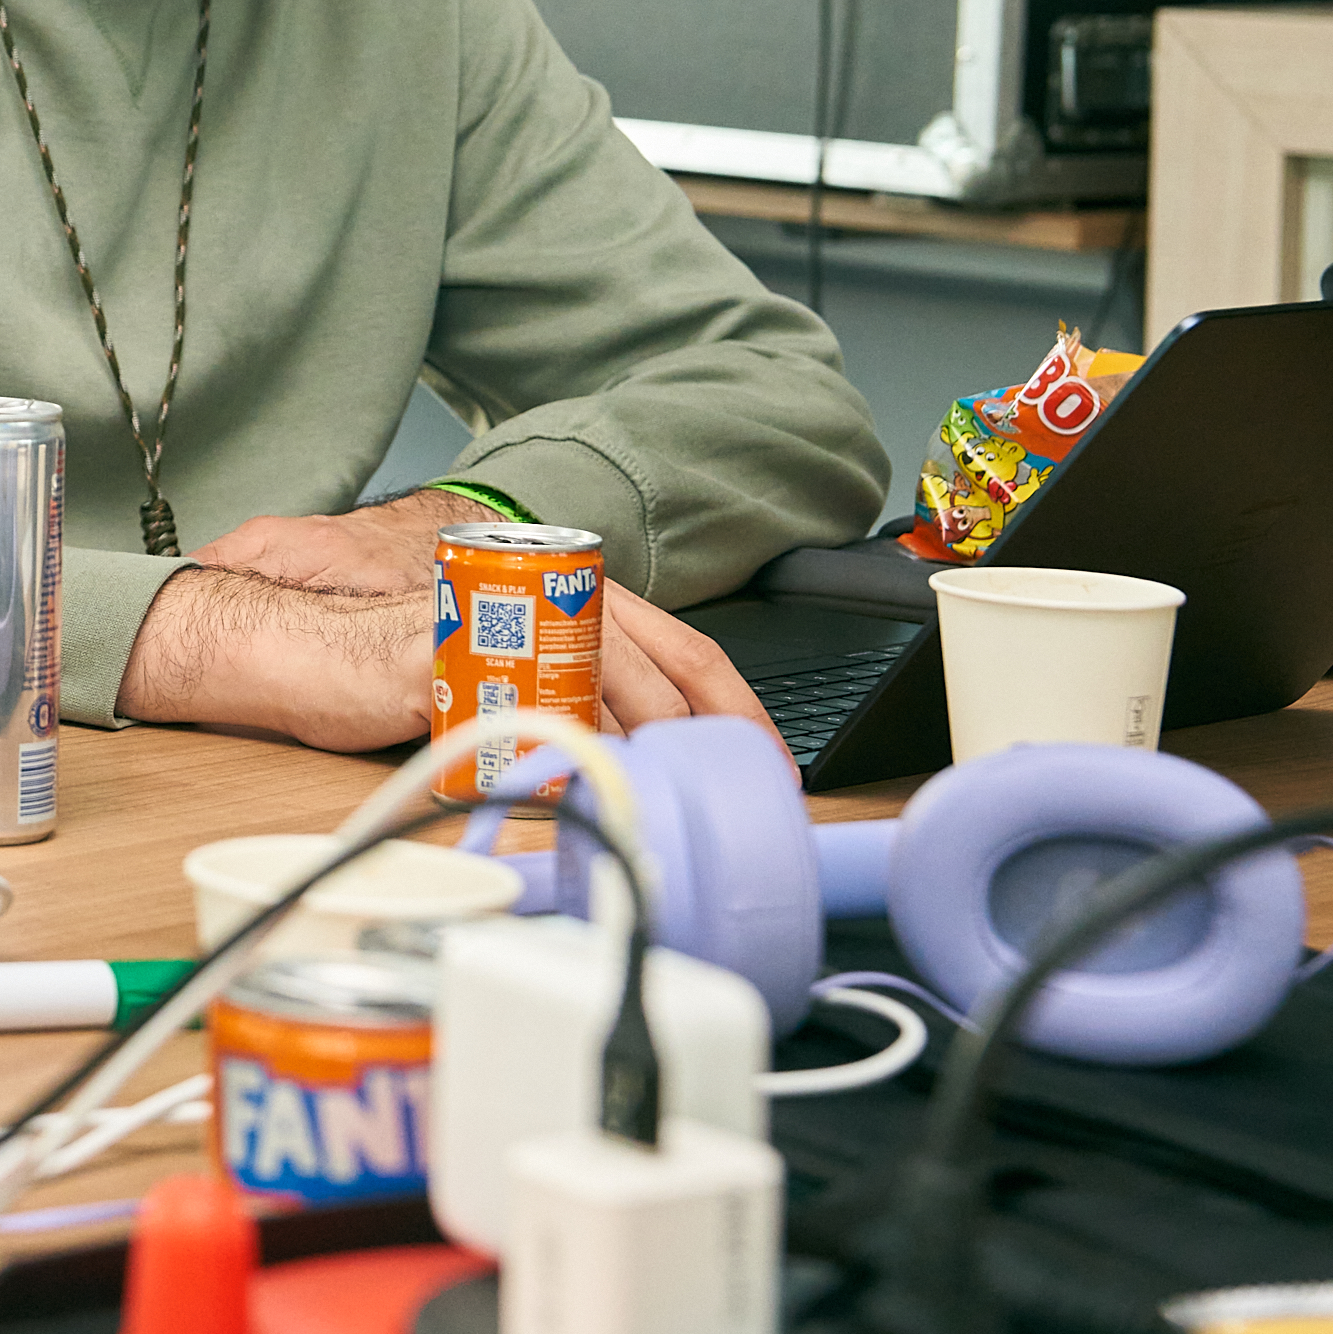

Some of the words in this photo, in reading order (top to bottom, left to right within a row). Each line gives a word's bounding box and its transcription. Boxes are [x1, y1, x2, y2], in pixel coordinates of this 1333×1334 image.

[542, 567, 598, 598] FANTA
[508, 585, 527, 594] PLAY
[485, 658, 504, 668] SCAN
[505, 659, 516, 668] ME
